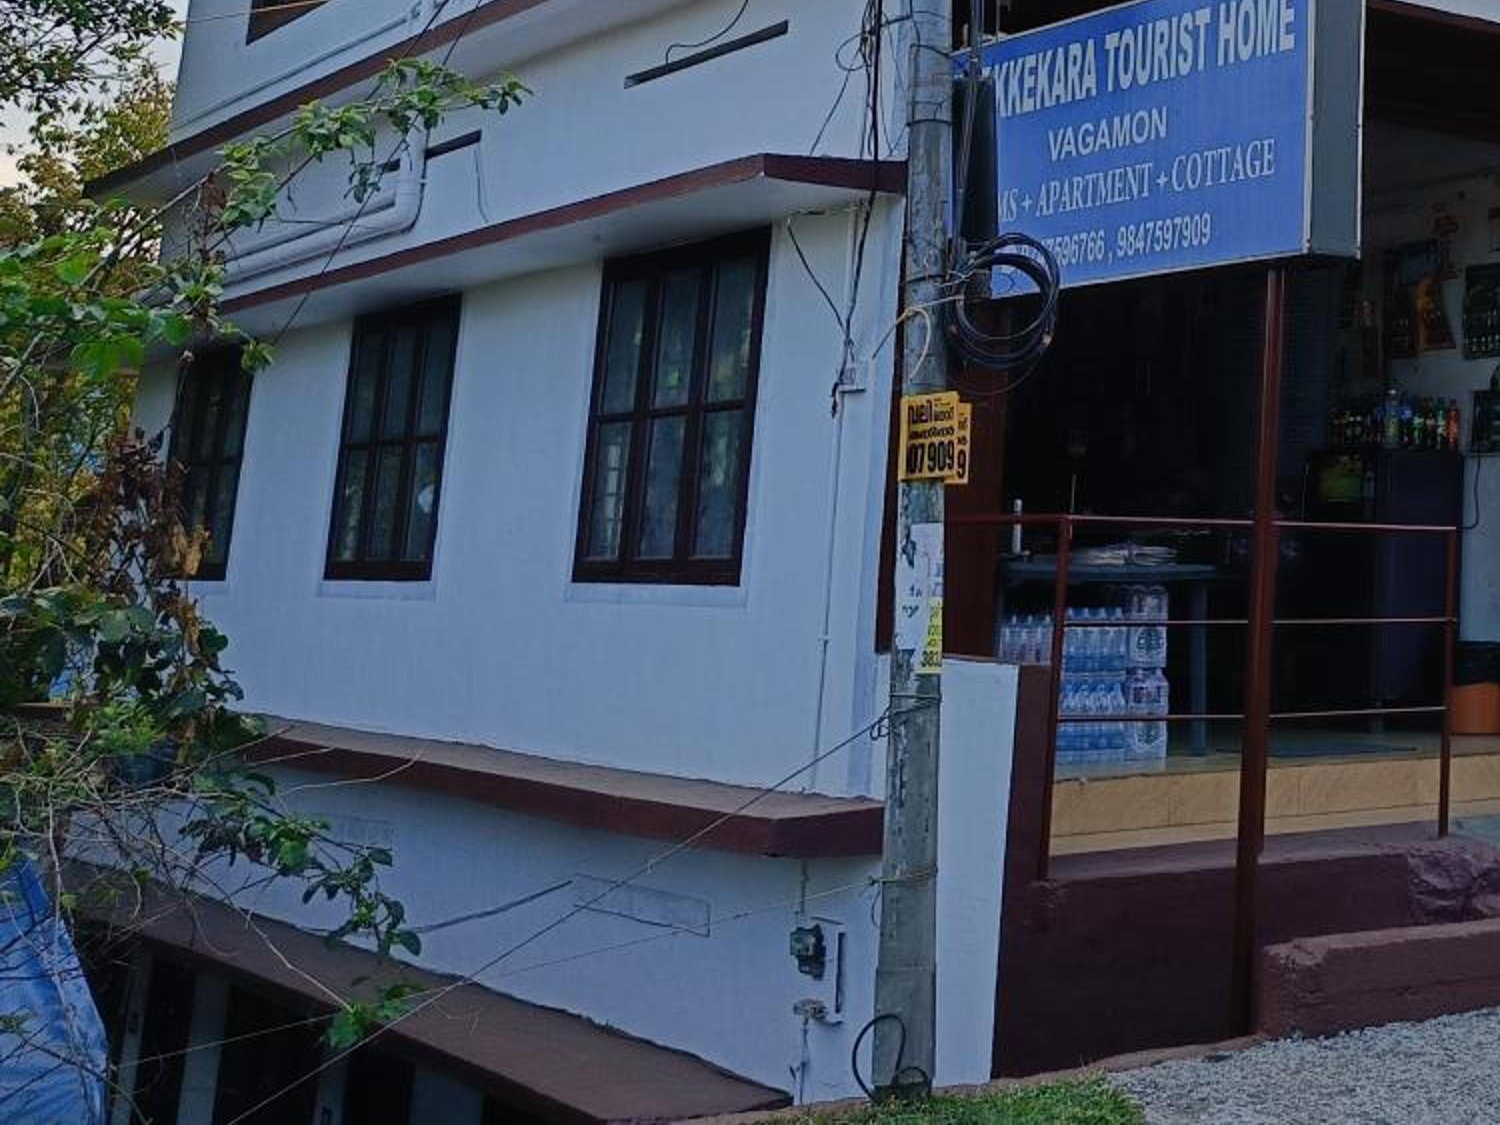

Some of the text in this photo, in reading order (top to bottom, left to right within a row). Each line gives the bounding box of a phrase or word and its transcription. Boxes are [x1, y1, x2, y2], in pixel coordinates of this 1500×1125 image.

[982, 38, 1097, 118] KKEKARA
[1104, 7, 1211, 92] TOURIST
[1048, 107, 1168, 162] VAGAMON
[1035, 162, 1152, 217] APARTMENT
[1171, 138, 1276, 193] COTTAGE
[1117, 212, 1211, 257] 9847597909
